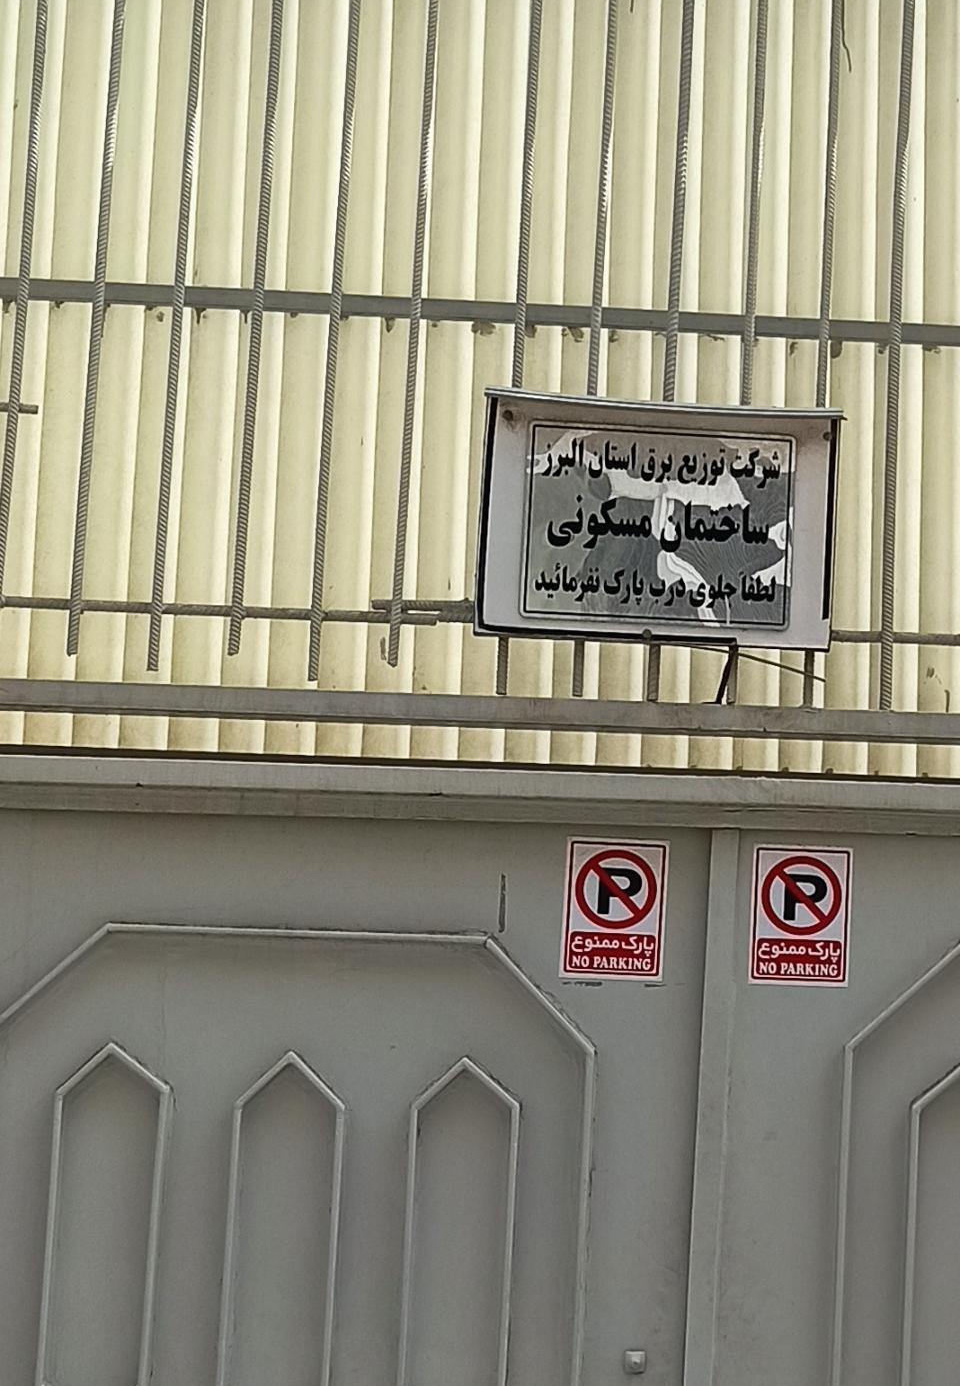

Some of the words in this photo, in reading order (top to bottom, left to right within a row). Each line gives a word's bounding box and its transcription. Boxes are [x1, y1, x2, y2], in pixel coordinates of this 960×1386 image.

[542, 438, 584, 477] البرز
[588, 439, 636, 478] استان
[640, 448, 672, 483] برق
[677, 448, 725, 486] توزیع
[729, 448, 781, 489] شرکت
[547, 494, 651, 549] مسکونی
[660, 500, 769, 553] ساختمان
[534, 563, 600, 602] نفرمائید
[603, 568, 644, 605] پارک
[650, 577, 686, 606] درب
[689, 574, 737, 608] جلوی
[571, 936, 620, 953] ممنوع
[621, 936, 654, 957] پارک
[758, 942, 806, 959] ممنوع
[808, 942, 841, 963] پارک
[571, 955, 591, 968] NO
[593, 956, 651, 970] PARKING
[759, 961, 777, 974] NO
[780, 962, 838, 976] PARKING
